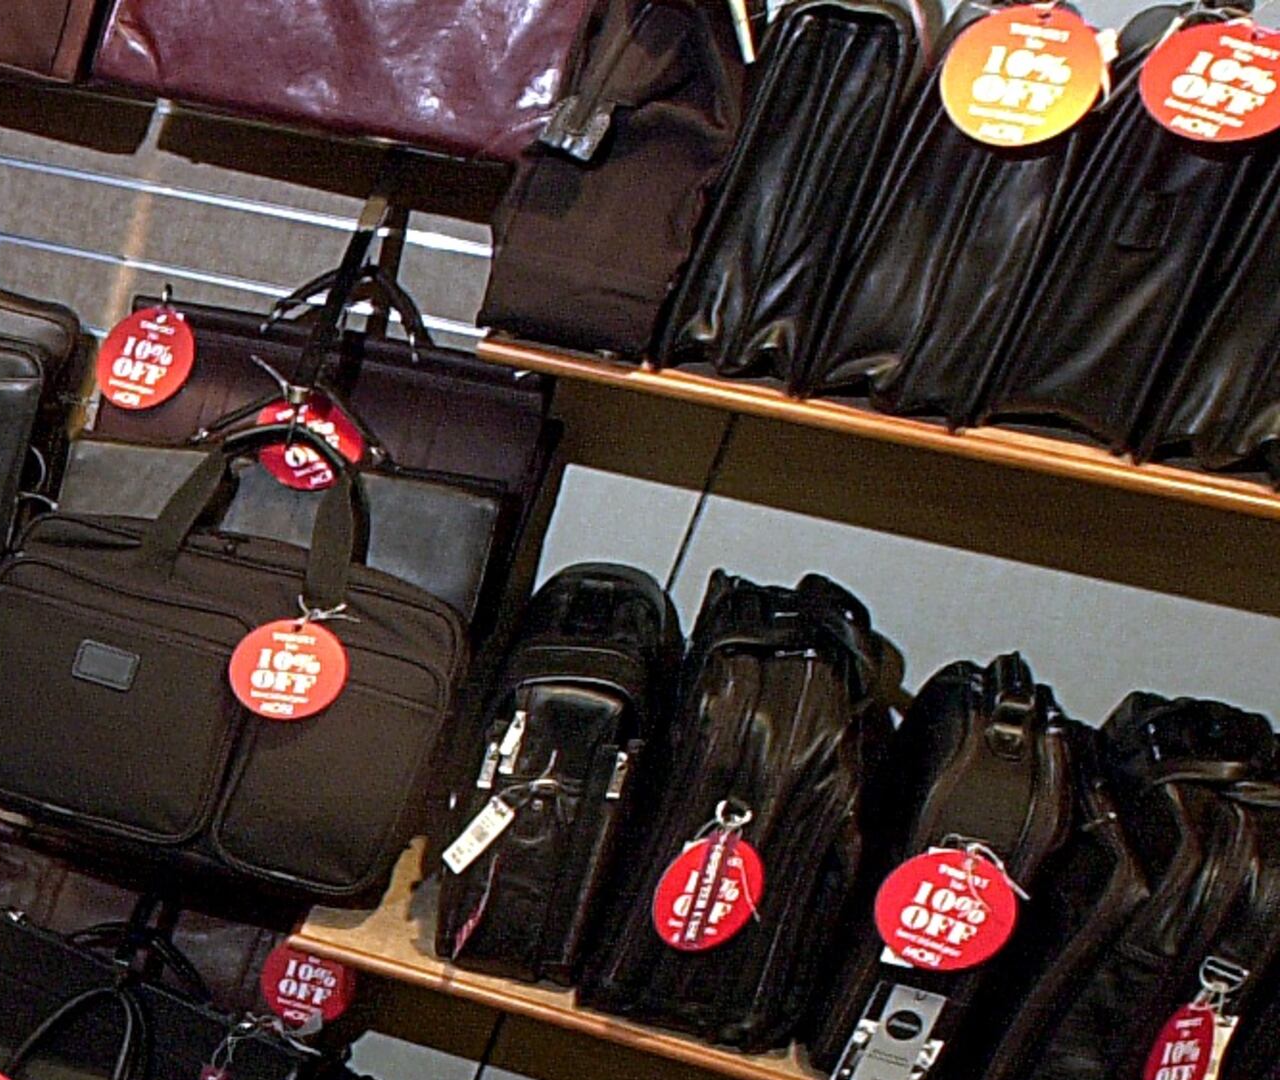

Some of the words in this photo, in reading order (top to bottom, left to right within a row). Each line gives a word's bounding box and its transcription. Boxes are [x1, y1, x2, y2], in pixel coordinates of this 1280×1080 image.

[983, 45, 1071, 84] 10%
[1186, 50, 1276, 94] 10%
[972, 74, 1064, 112] OFF
[1171, 74, 1265, 115] OFF
[122, 335, 173, 366] 10%
[112, 356, 167, 385] OFF
[258, 648, 321, 675] 10%
[250, 669, 317, 694] OFF
[913, 881, 986, 924] 10%
[900, 905, 977, 945] OFF
[284, 959, 336, 988] 10%
[278, 978, 332, 1005] OFF
[1161, 1039, 1200, 1065] 10%
